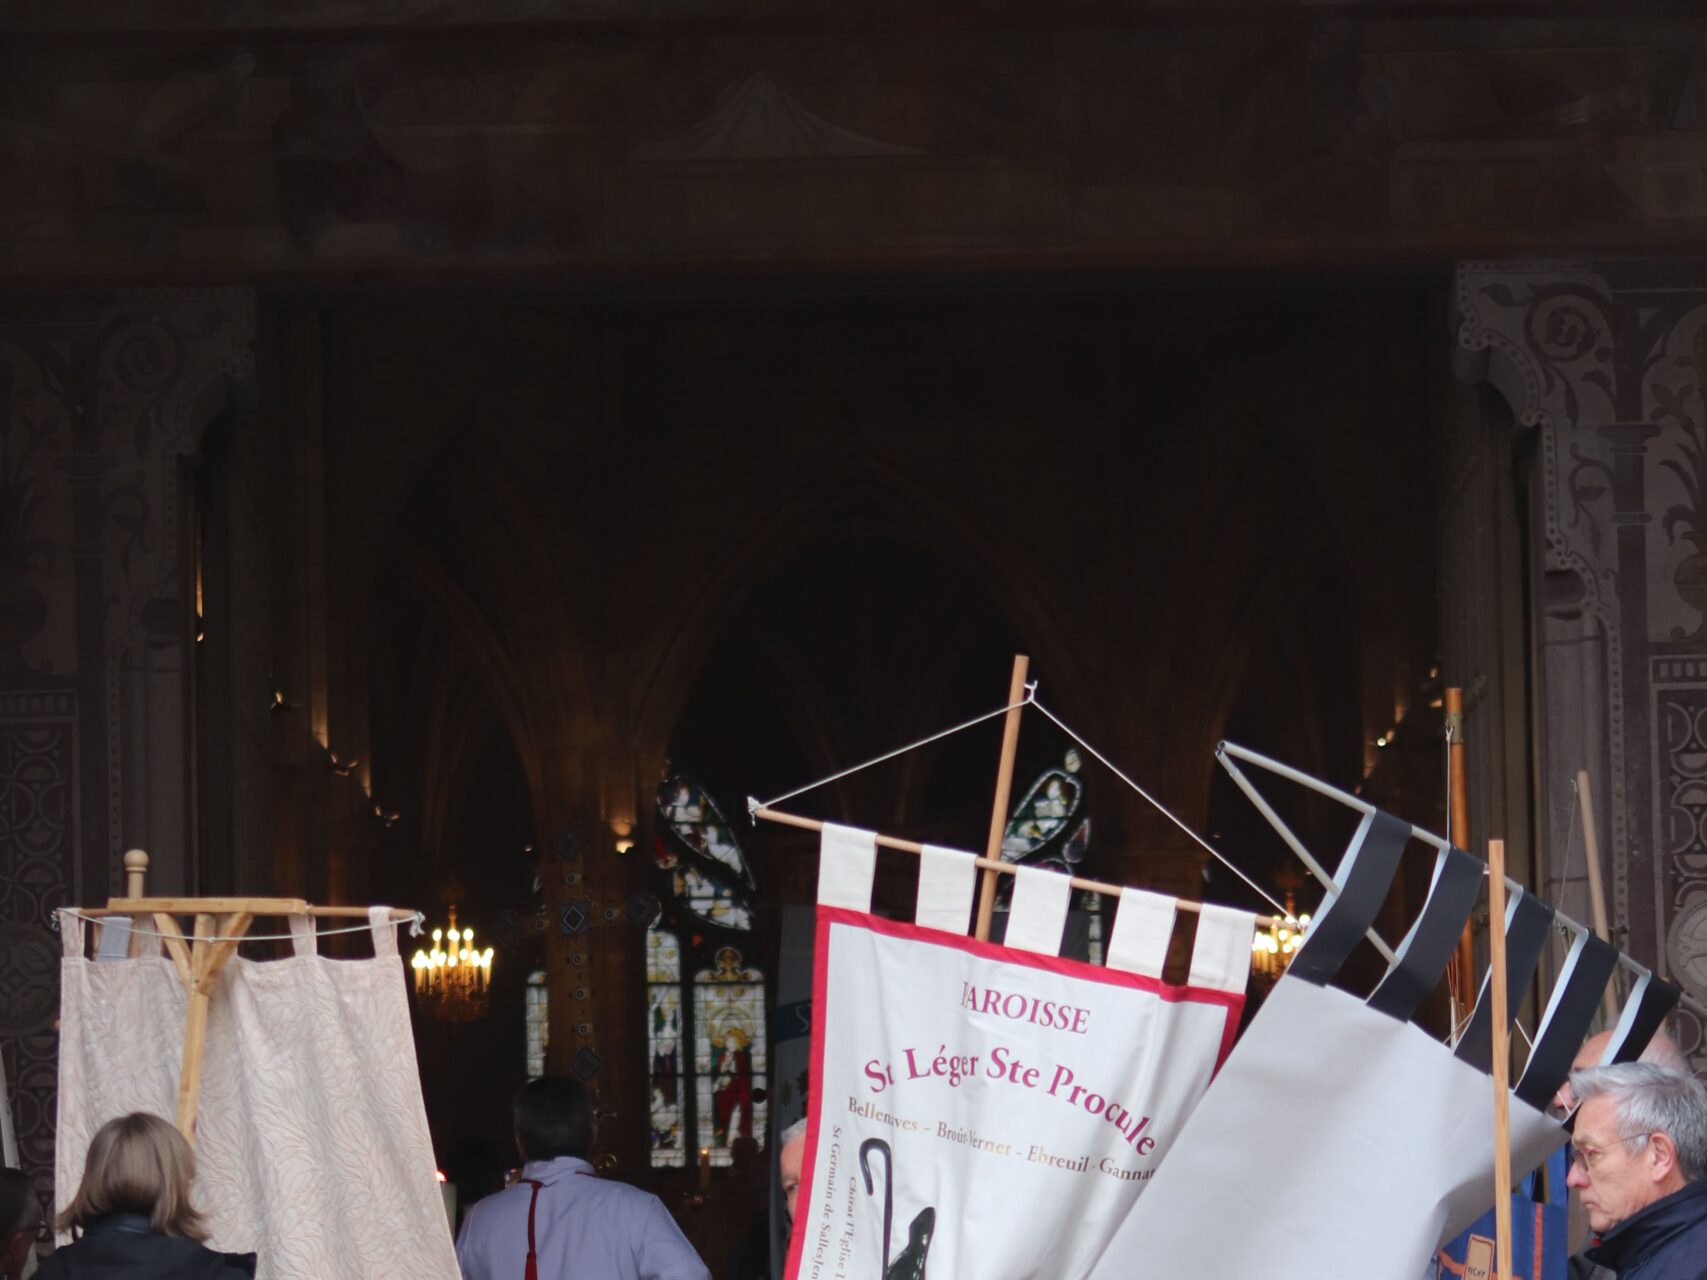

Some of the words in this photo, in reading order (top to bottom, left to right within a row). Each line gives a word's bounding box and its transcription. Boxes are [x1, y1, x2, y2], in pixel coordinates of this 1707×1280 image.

[864, 1059, 895, 1093] St
[902, 1044, 979, 1087] Léger
[986, 1047, 1040, 1088] Ste
[1046, 1064, 1155, 1156] Procule
[825, 1143, 841, 1200] Germain
[823, 1203, 834, 1219] de
